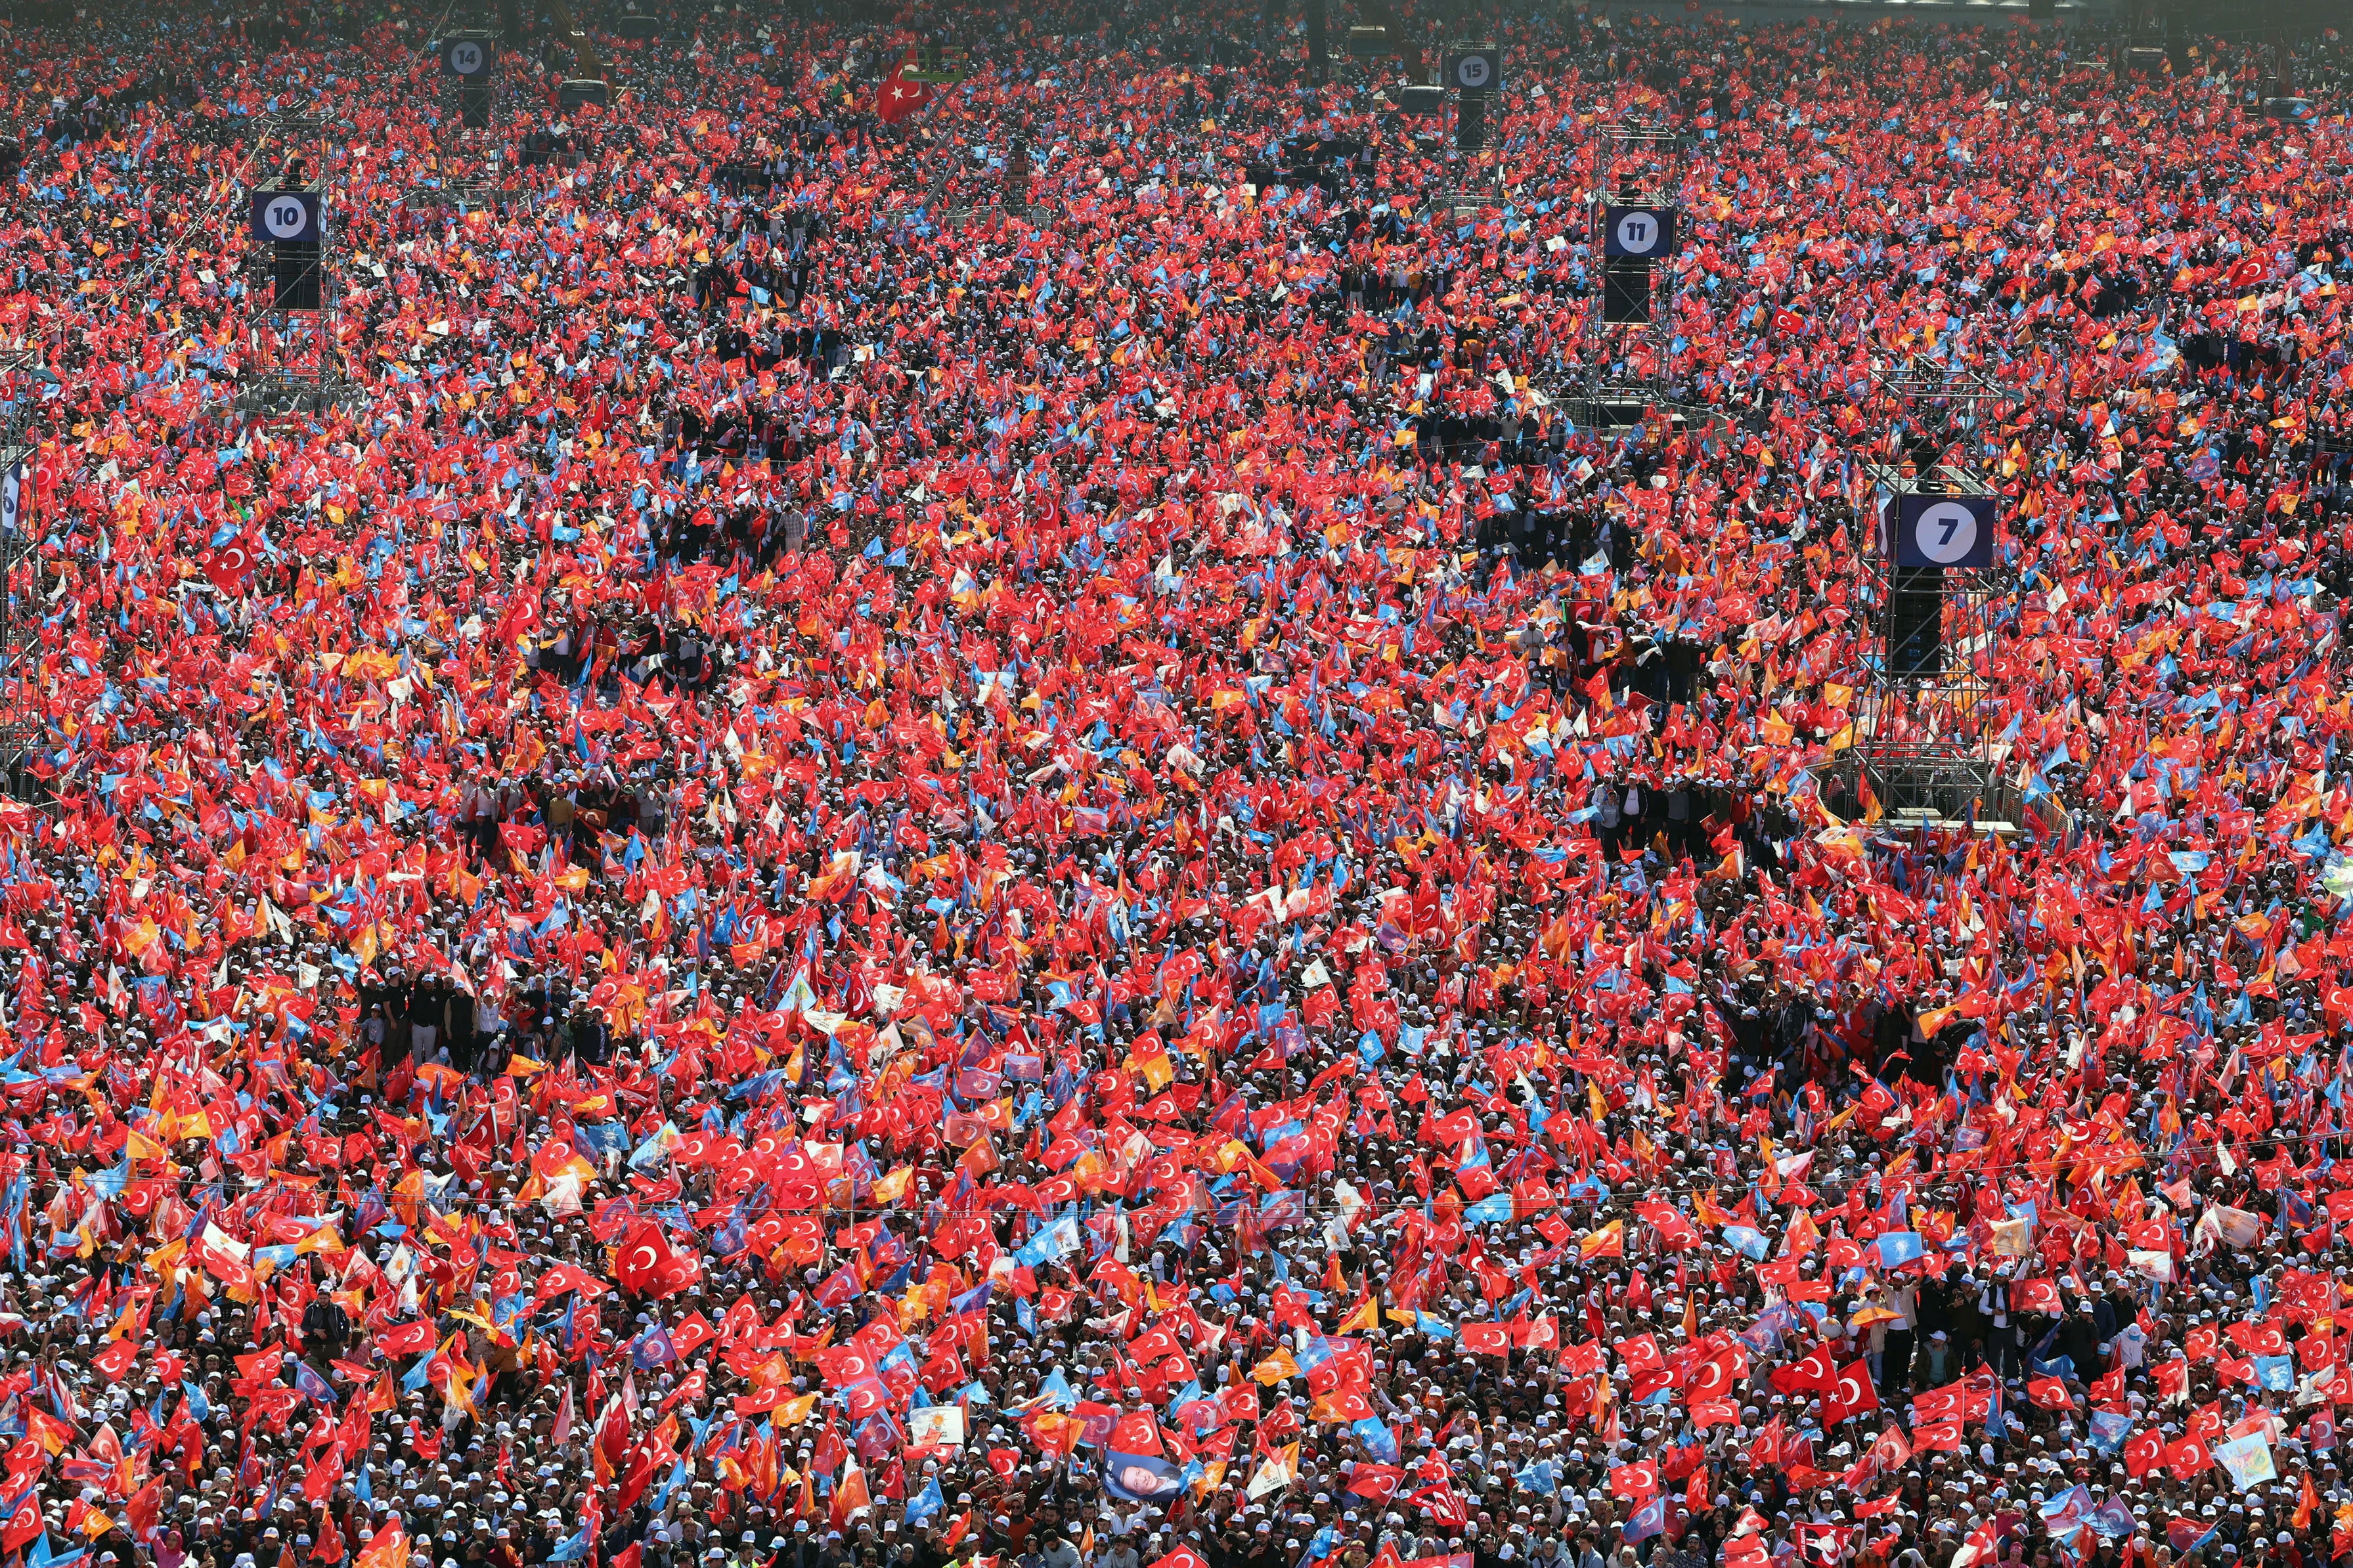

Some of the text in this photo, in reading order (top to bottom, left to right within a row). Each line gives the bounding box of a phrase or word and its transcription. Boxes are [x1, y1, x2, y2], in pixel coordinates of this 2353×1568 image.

[458, 50, 476, 64] 14
[1464, 64, 1482, 78] 15
[273, 207, 298, 226] 10
[1627, 223, 1646, 242] 11
[1938, 518, 1958, 545] 7
